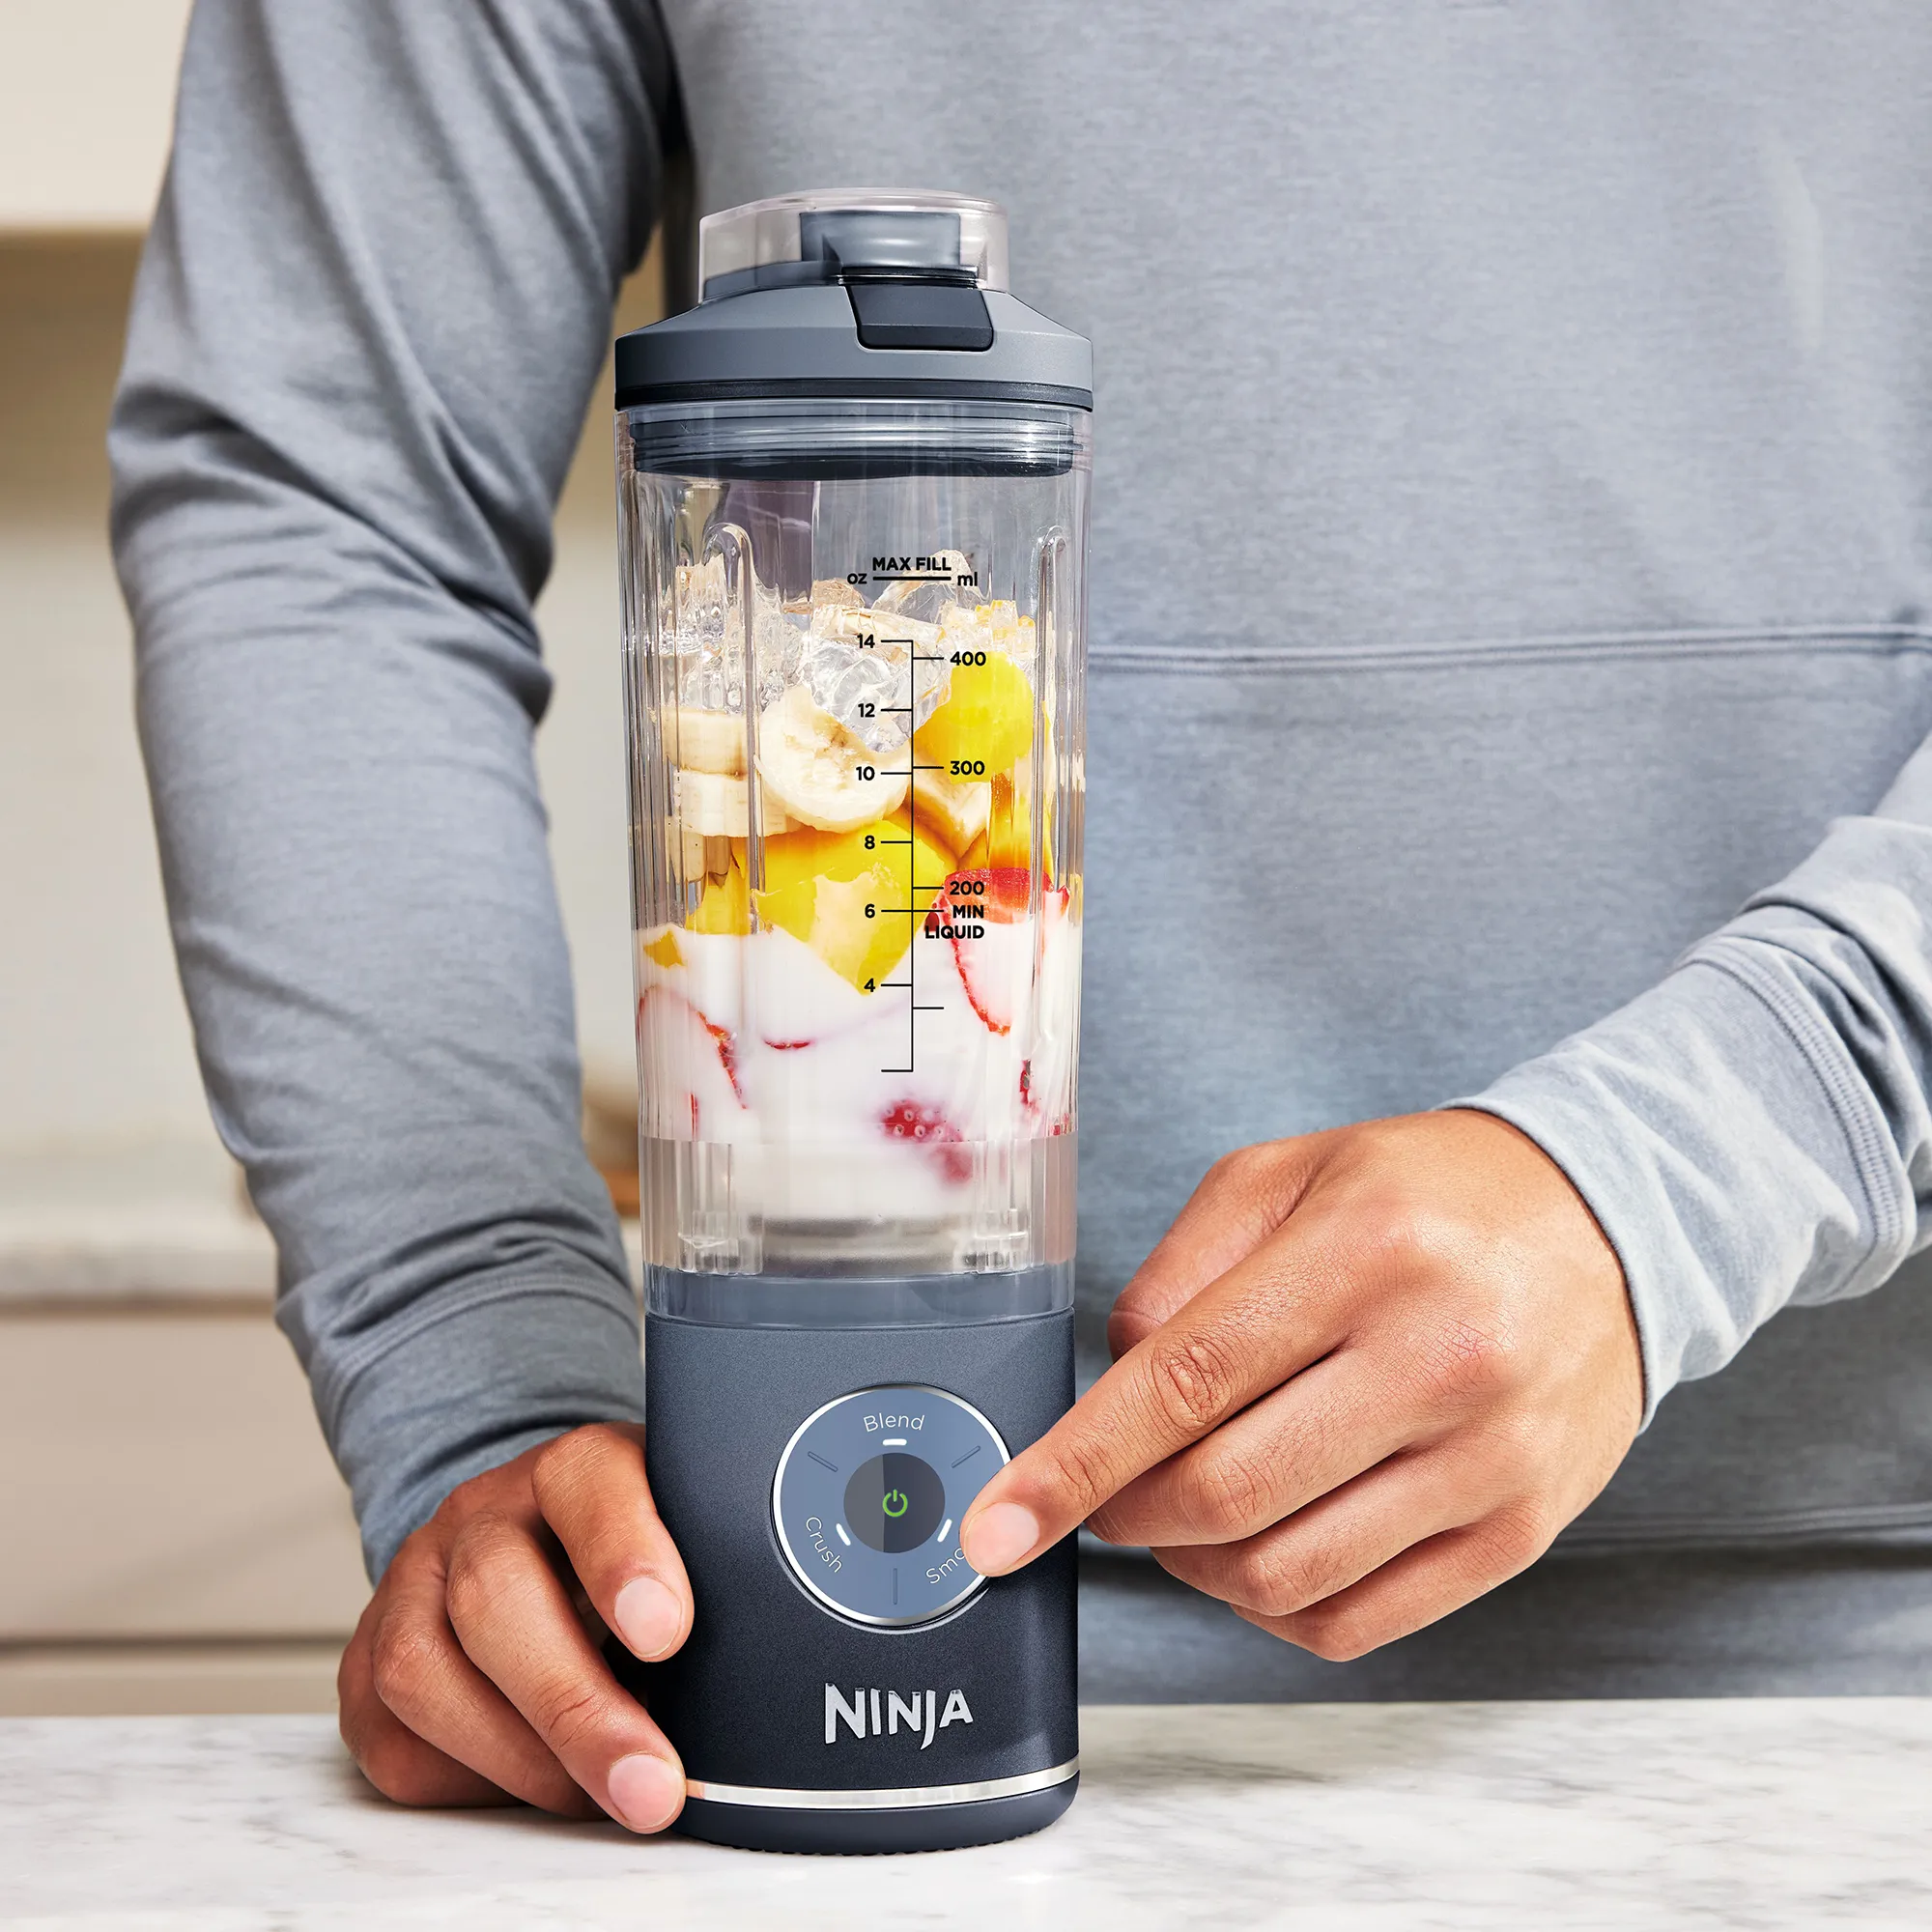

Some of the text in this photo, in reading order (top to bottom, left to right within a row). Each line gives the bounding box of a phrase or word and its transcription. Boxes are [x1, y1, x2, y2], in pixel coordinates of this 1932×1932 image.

[872, 556, 952, 572] MAX FILL
[846, 573, 867, 585] oz
[956, 571, 979, 587] ml
[857, 633, 876, 649] 14
[950, 651, 986, 667] 400
[857, 702, 875, 718] 12
[855, 765, 875, 781] 10
[950, 760, 985, 776] 300
[864, 835, 875, 850] 8
[950, 880, 984, 895] 200
[865, 903, 876, 919] 6
[952, 904, 984, 919] MIN
[924, 924, 985, 941] LIQUID
[864, 978, 876, 993] 4
[863, 1412, 925, 1433] Blend
[805, 1516, 843, 1574] Crush
[825, 1682, 974, 1750] NINJA
